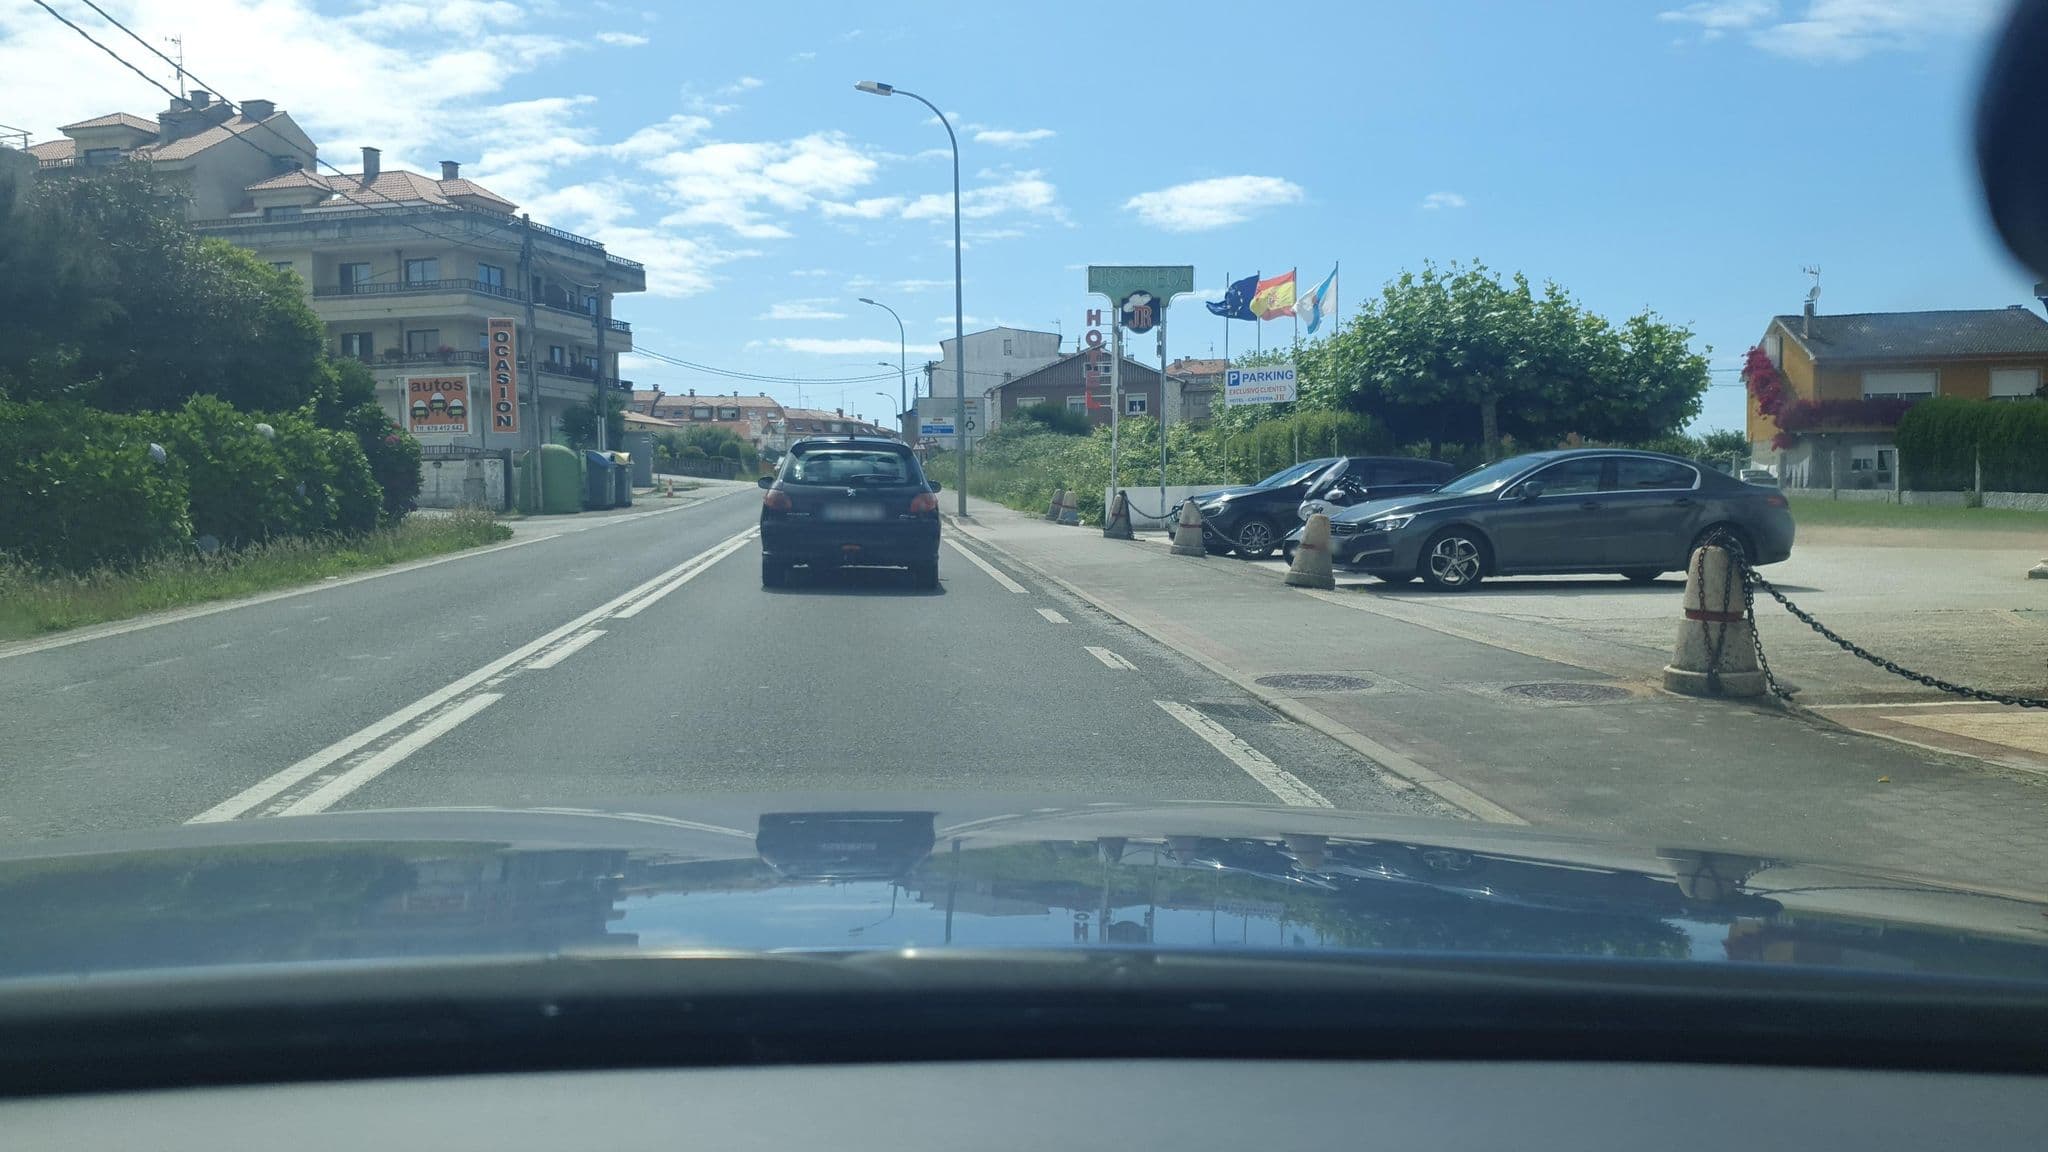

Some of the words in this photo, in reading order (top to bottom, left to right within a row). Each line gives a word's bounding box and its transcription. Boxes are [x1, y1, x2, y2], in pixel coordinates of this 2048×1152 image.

[1091, 267, 1193, 289] DISCOTECA
[1085, 309, 1102, 409] HOTEL
[411, 378, 464, 392] autos
[493, 330, 513, 427] OCASION
[1229, 372, 1239, 385] P
[1242, 370, 1294, 383] PARKING
[1229, 387, 1259, 395] EXCLUSIVO
[1260, 385, 1286, 393] CLIENTES
